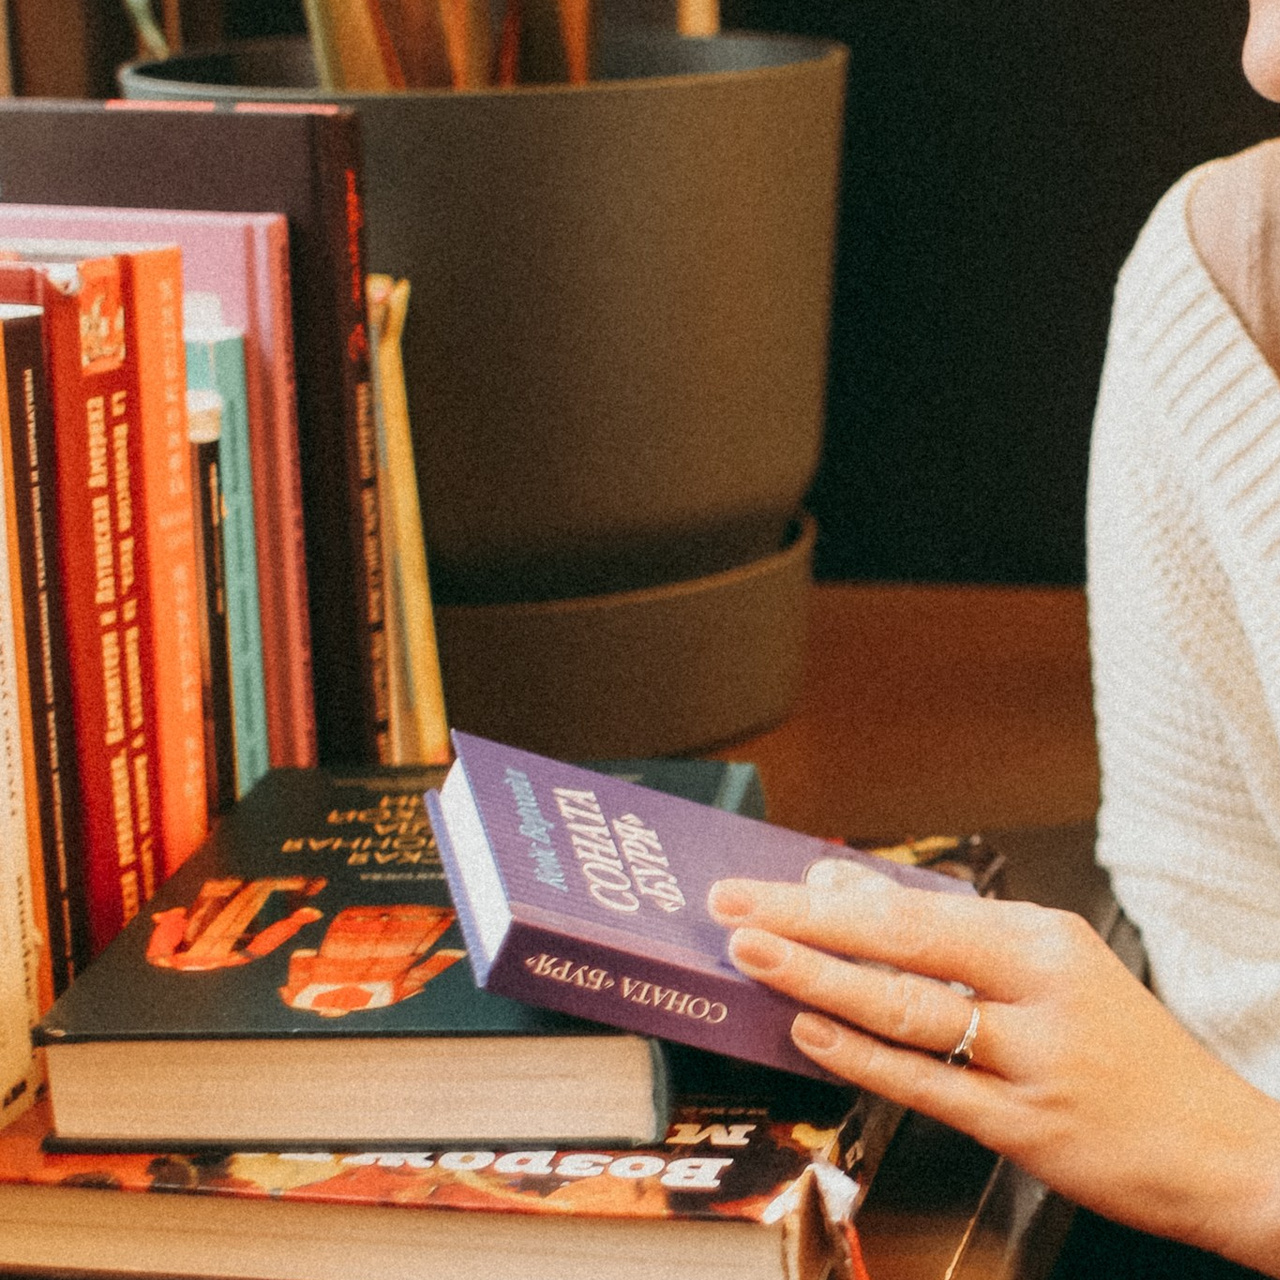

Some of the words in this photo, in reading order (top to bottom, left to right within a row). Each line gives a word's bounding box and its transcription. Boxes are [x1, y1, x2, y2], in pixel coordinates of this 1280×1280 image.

[86, 395, 108, 488] Америка
[92, 494, 116, 604] Латинская
[552, 787, 640, 912] СОНАТА
[612, 812, 686, 912] «БУРЯ»
[524, 953, 616, 991] «БУРЯ»
[620, 976, 728, 1024] СОНАТА
